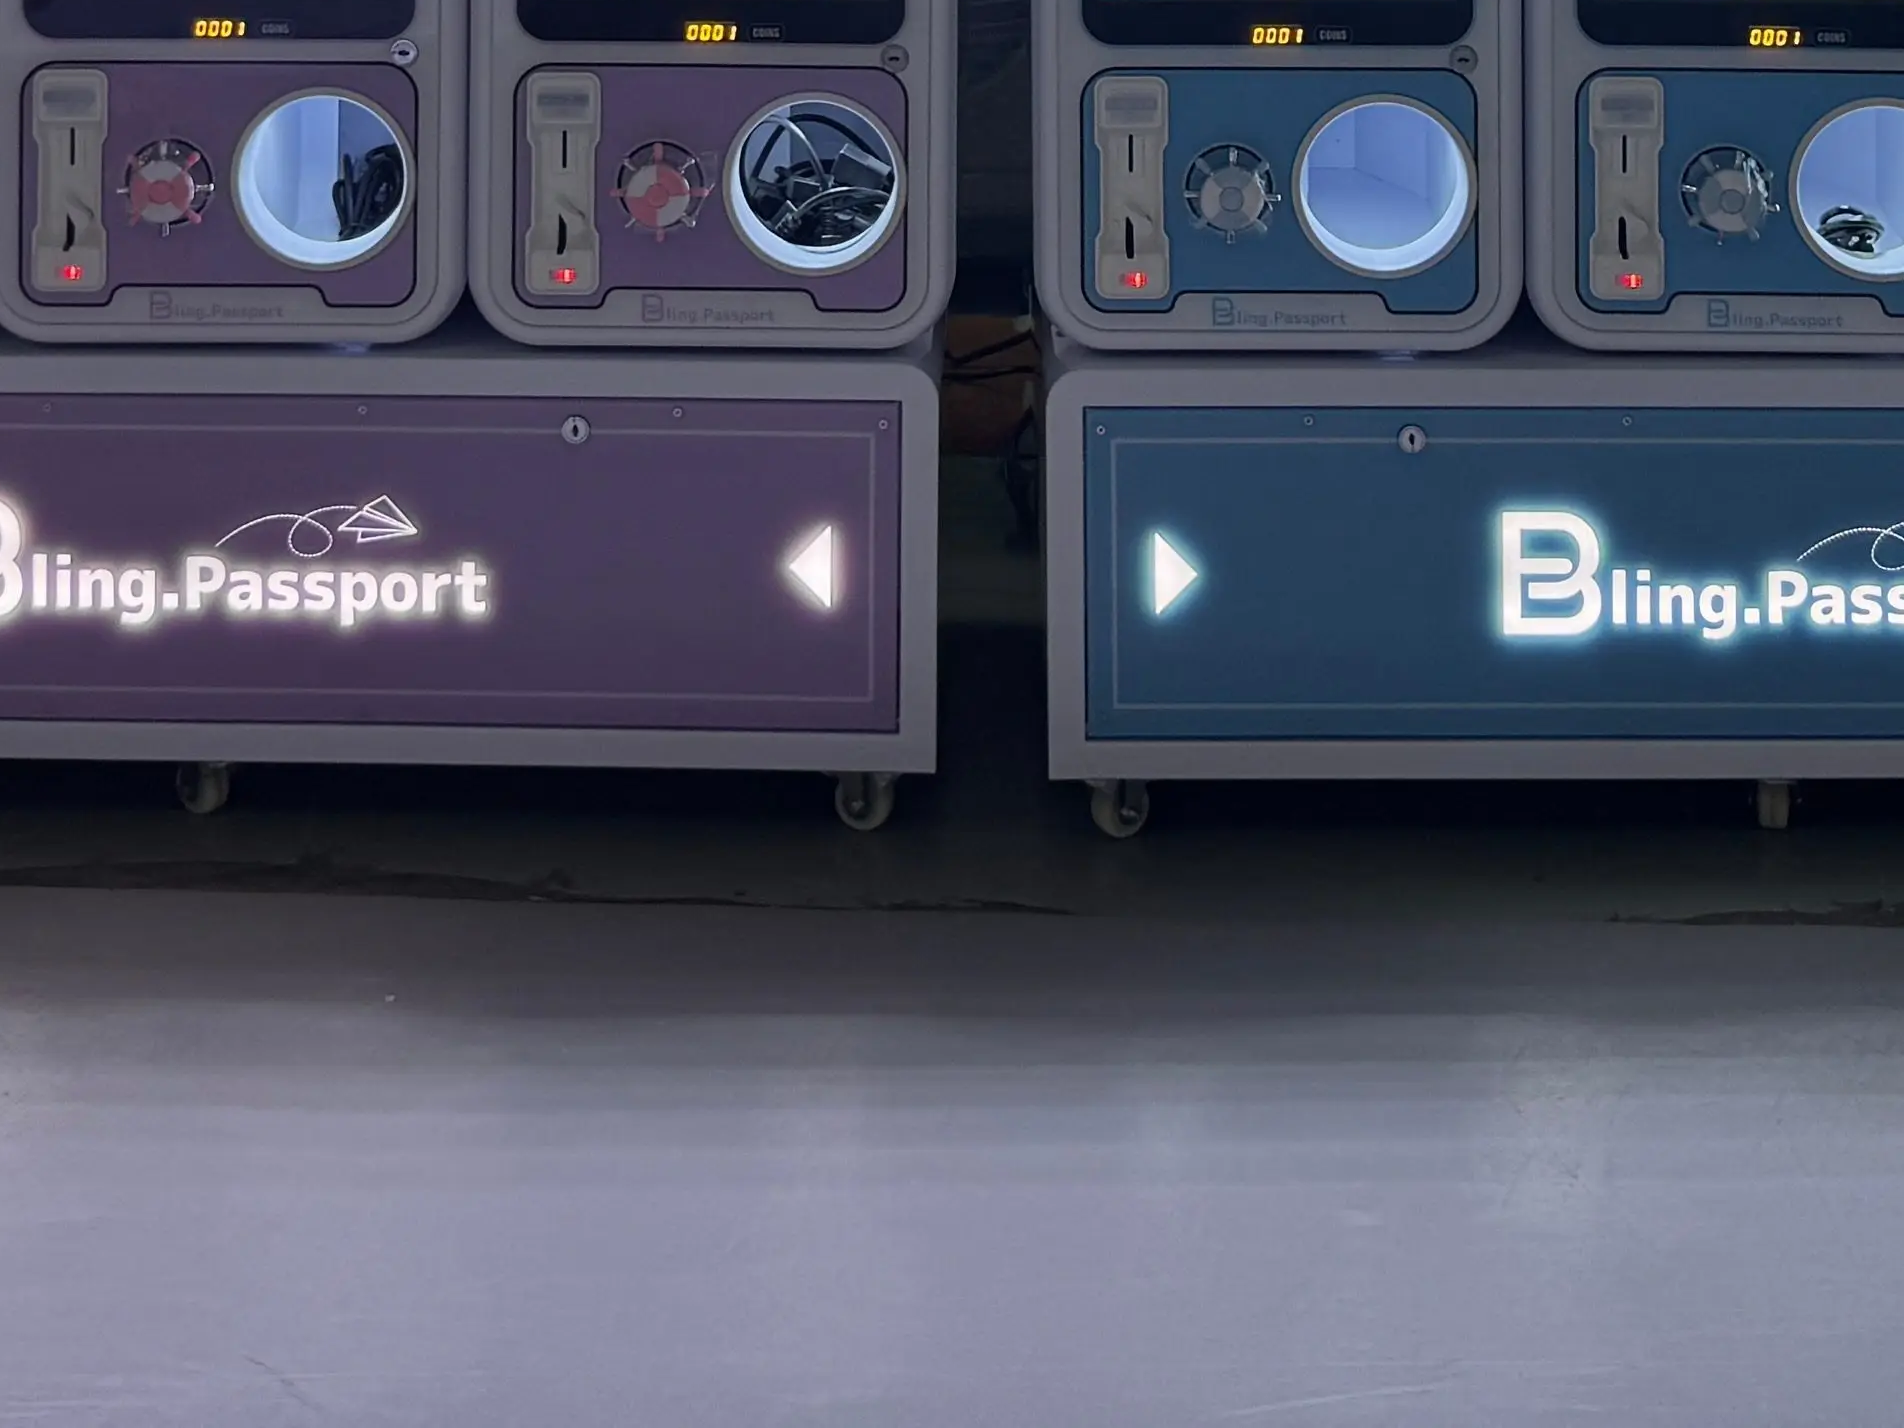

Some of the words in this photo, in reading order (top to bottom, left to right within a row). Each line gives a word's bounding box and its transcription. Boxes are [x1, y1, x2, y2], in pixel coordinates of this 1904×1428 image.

[195, 20, 245, 37] 0001
[686, 24, 736, 41] 0001
[752, 27, 779, 38] COINS
[1252, 27, 1303, 44] 0001
[1319, 29, 1346, 40] COINS
[1749, 28, 1800, 46] 0001
[1817, 32, 1845, 43] COINS
